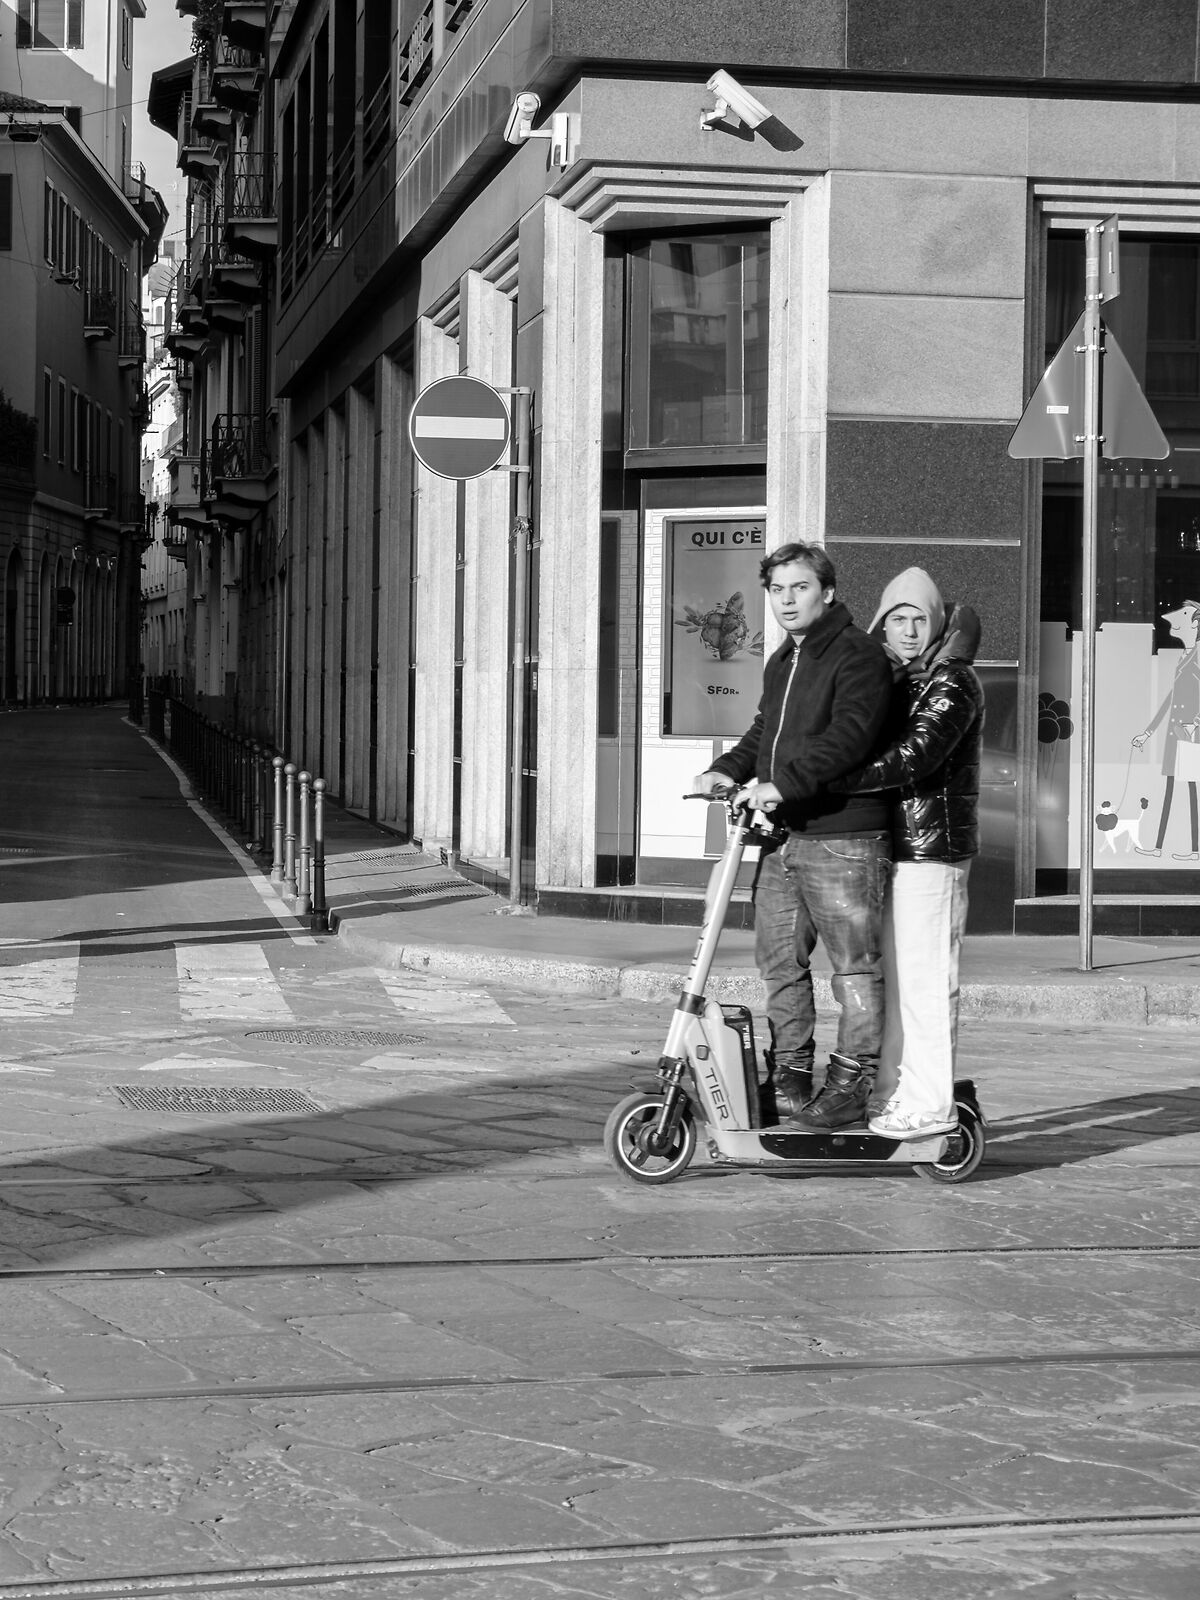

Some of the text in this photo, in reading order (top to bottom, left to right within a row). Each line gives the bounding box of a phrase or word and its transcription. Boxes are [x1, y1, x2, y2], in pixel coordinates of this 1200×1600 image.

[691, 526, 762, 547] QUI C'È
[742, 1024, 752, 1050] TIER
[705, 1067, 729, 1120] TIER
